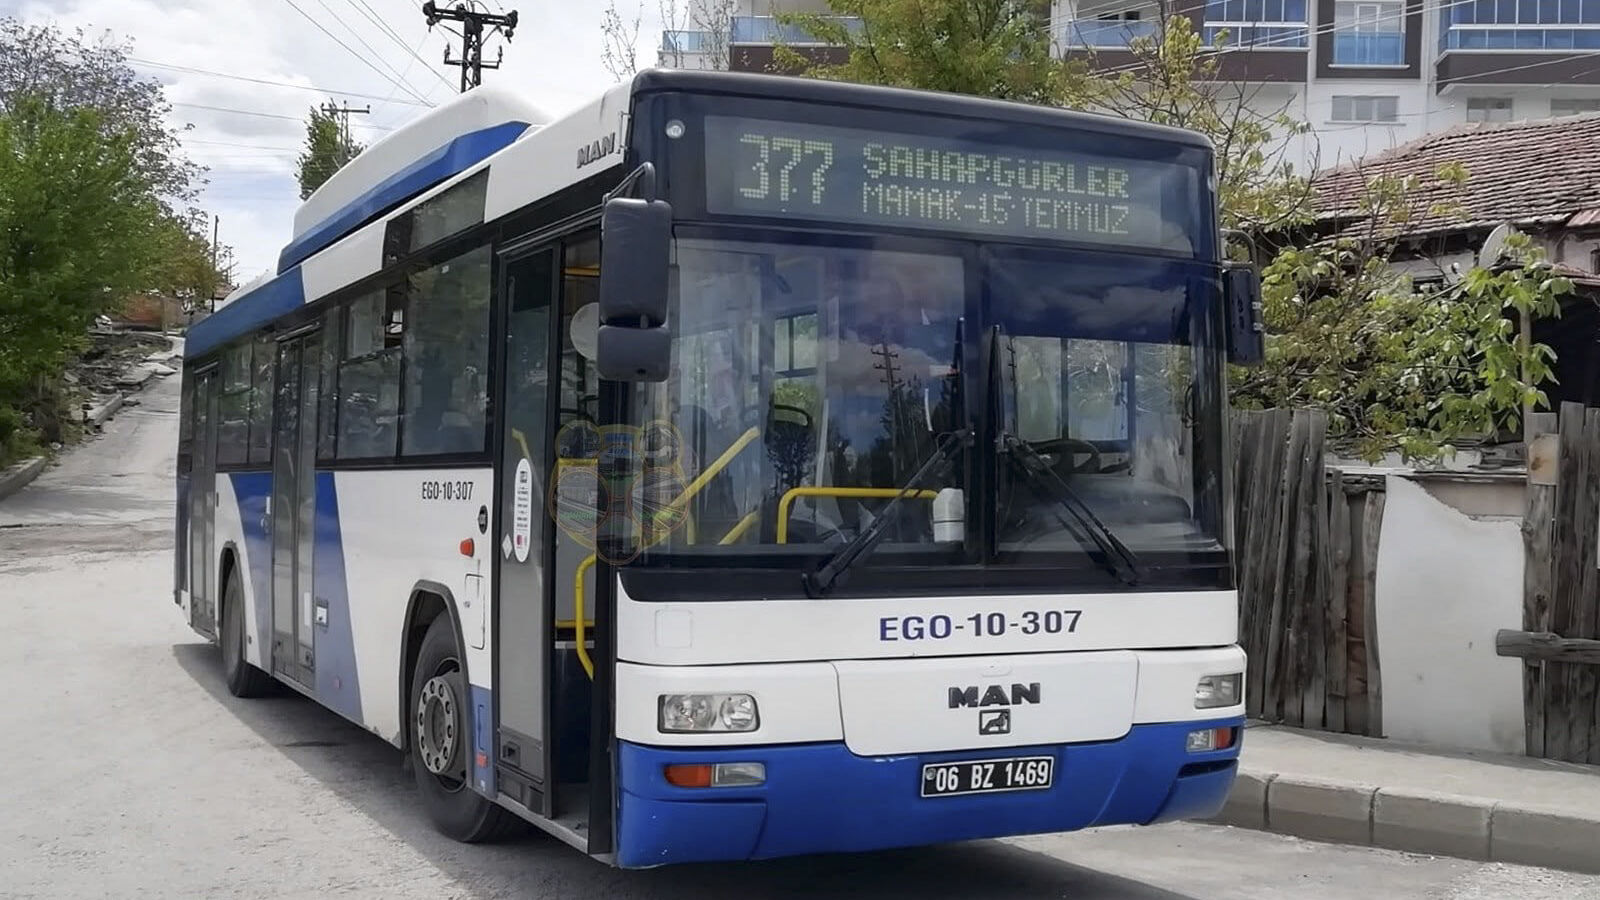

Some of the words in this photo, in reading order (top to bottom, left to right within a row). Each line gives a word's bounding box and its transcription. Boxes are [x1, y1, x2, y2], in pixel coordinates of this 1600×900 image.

[577, 132, 616, 169] MAN
[740, 134, 833, 204] 377
[1021, 197, 1129, 234] TEMMUZ
[422, 481, 474, 500] EGO-10-307
[879, 610, 1083, 642] EGO-10-307
[948, 682, 1041, 709] MAN
[936, 766, 959, 792] 06
[970, 763, 995, 789] BZ
[1005, 760, 1049, 786] 1469
